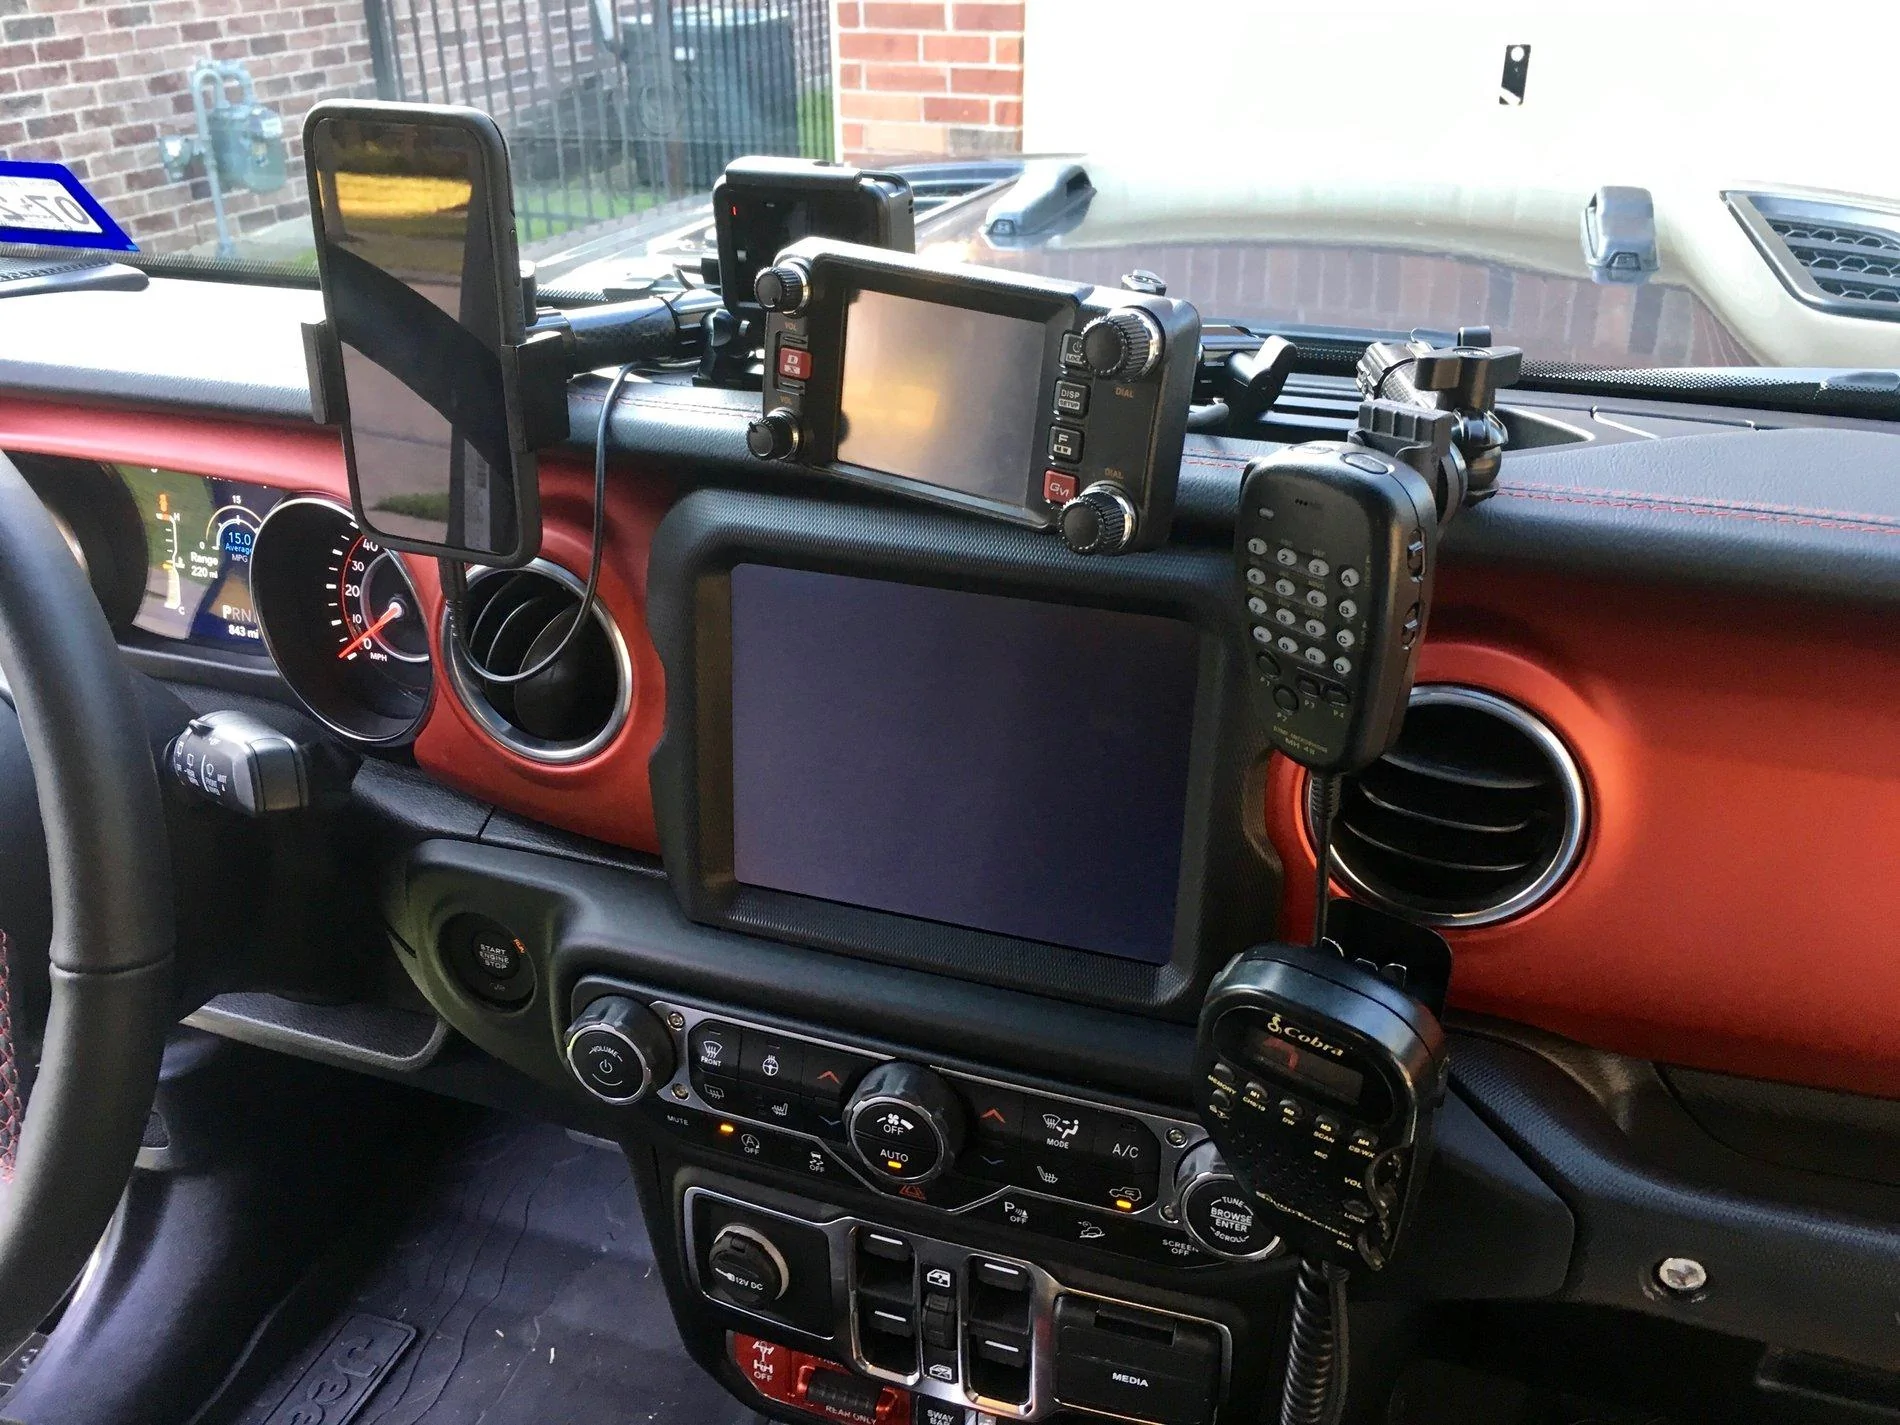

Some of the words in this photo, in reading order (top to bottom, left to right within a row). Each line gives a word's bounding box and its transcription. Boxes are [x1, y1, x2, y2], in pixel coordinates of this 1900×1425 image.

[1061, 389, 1080, 399] DISP
[1115, 387, 1134, 399] DIAL
[1059, 399, 1080, 409] SETUP
[1058, 434, 1069, 442] F
[1105, 468, 1123, 480] DIAL
[228, 532, 252, 545] 15.0
[190, 552, 219, 566] Range
[231, 554, 248, 562] MPG
[191, 566, 209, 578] 220
[352, 561, 365, 572] 30
[345, 584, 361, 597] 20
[352, 614, 362, 624] 10
[228, 624, 246, 637] 843
[363, 638, 373, 650] 0
[370, 652, 388, 662] MPH
[480, 944, 506, 955] START
[479, 951, 510, 964] ENGINE
[484, 959, 507, 970] STOP
[1284, 1026, 1344, 1057] Cobra
[592, 1045, 618, 1058] VOLUME
[701, 1055, 722, 1067] FRONT
[1207, 1074, 1237, 1095] MEMORY
[667, 1114, 689, 1126] MUTE
[883, 1124, 904, 1136] OFF
[1313, 1131, 1335, 1143] SCAN
[1357, 1138, 1370, 1147] M4
[1046, 1138, 1069, 1149] MODE
[744, 1146, 759, 1155] OFF
[880, 1148, 909, 1163] AUTO
[1112, 1143, 1139, 1159] A/C
[809, 1164, 825, 1173] OFF
[1344, 1177, 1363, 1189] VOL
[1221, 1196, 1245, 1209] TUNE
[1010, 1215, 1027, 1224] OFF
[1210, 1207, 1253, 1223] BROWSE
[1343, 1212, 1365, 1224] LOCK
[1215, 1218, 1248, 1233] ENTER
[1215, 1230, 1244, 1243] SCROLL
[1171, 1247, 1190, 1257] OFF
[735, 1276, 749, 1287] 12V
[751, 1281, 764, 1291] DC
[753, 1371, 773, 1382] OFF
[1112, 1372, 1149, 1388] MEDIA
[825, 1405, 851, 1418] REAR
[852, 1412, 877, 1425] ONLY
[927, 1409, 955, 1422] SWAY
